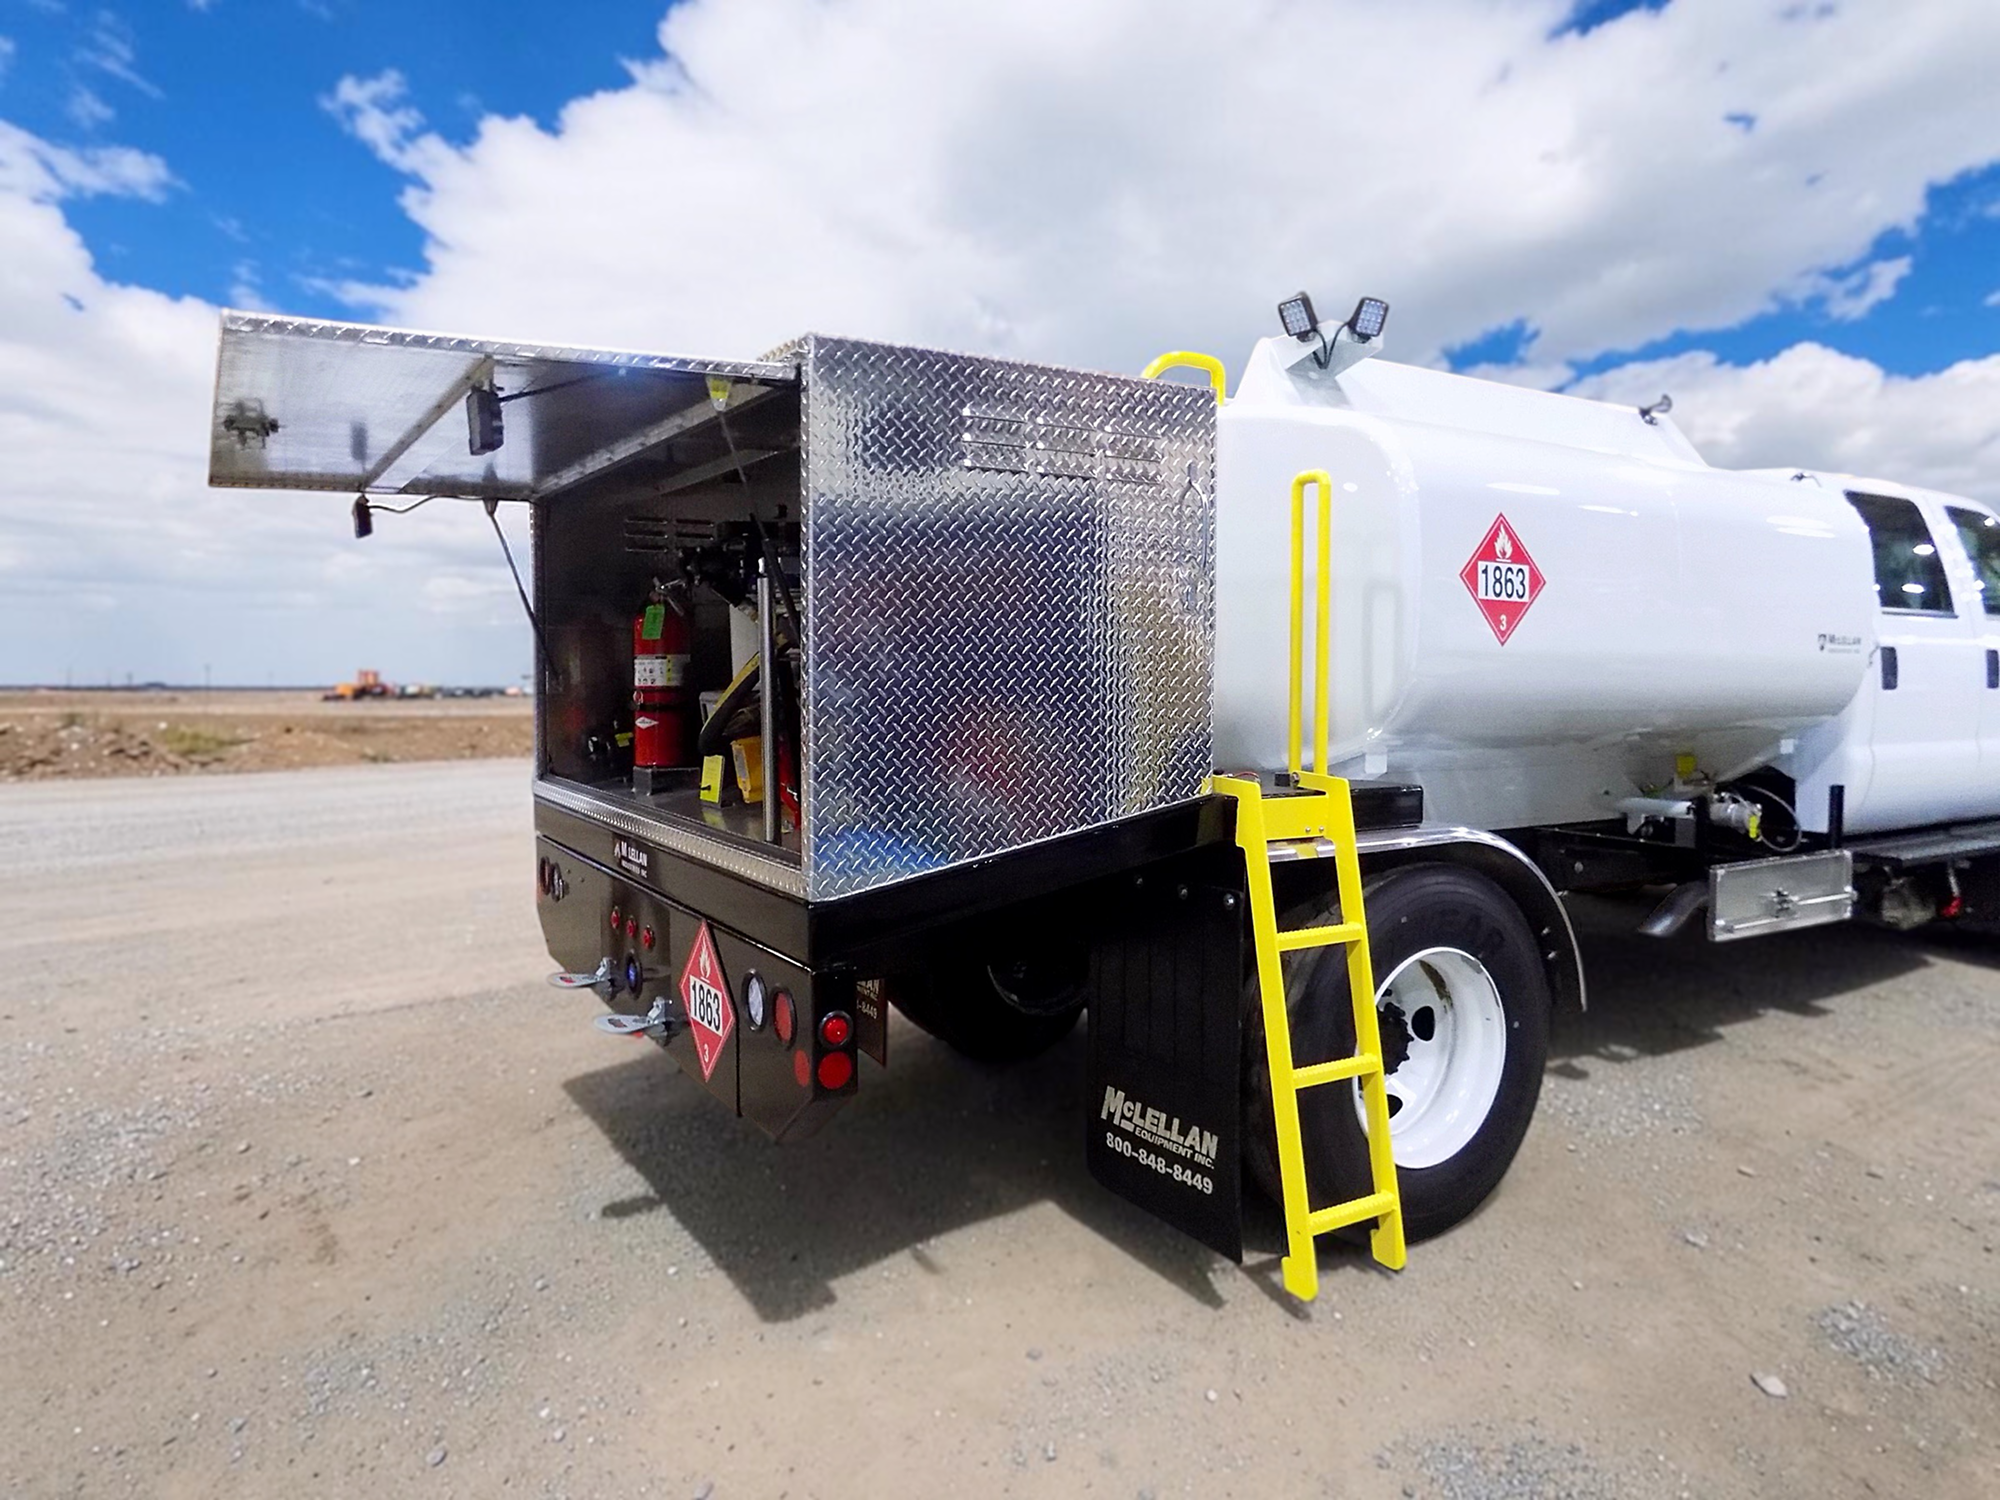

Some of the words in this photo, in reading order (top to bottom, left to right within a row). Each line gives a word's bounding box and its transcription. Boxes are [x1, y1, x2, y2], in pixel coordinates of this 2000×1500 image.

[1481, 564, 1526, 599] 1863
[1499, 613, 1507, 631] 3
[692, 980, 721, 1032] 1863
[703, 1043, 709, 1063] 3
[1105, 1131, 1214, 1195] 800-848-8449
[1134, 1126, 1194, 1159] EQUIPMENT
[1193, 1151, 1215, 1170] INC.
